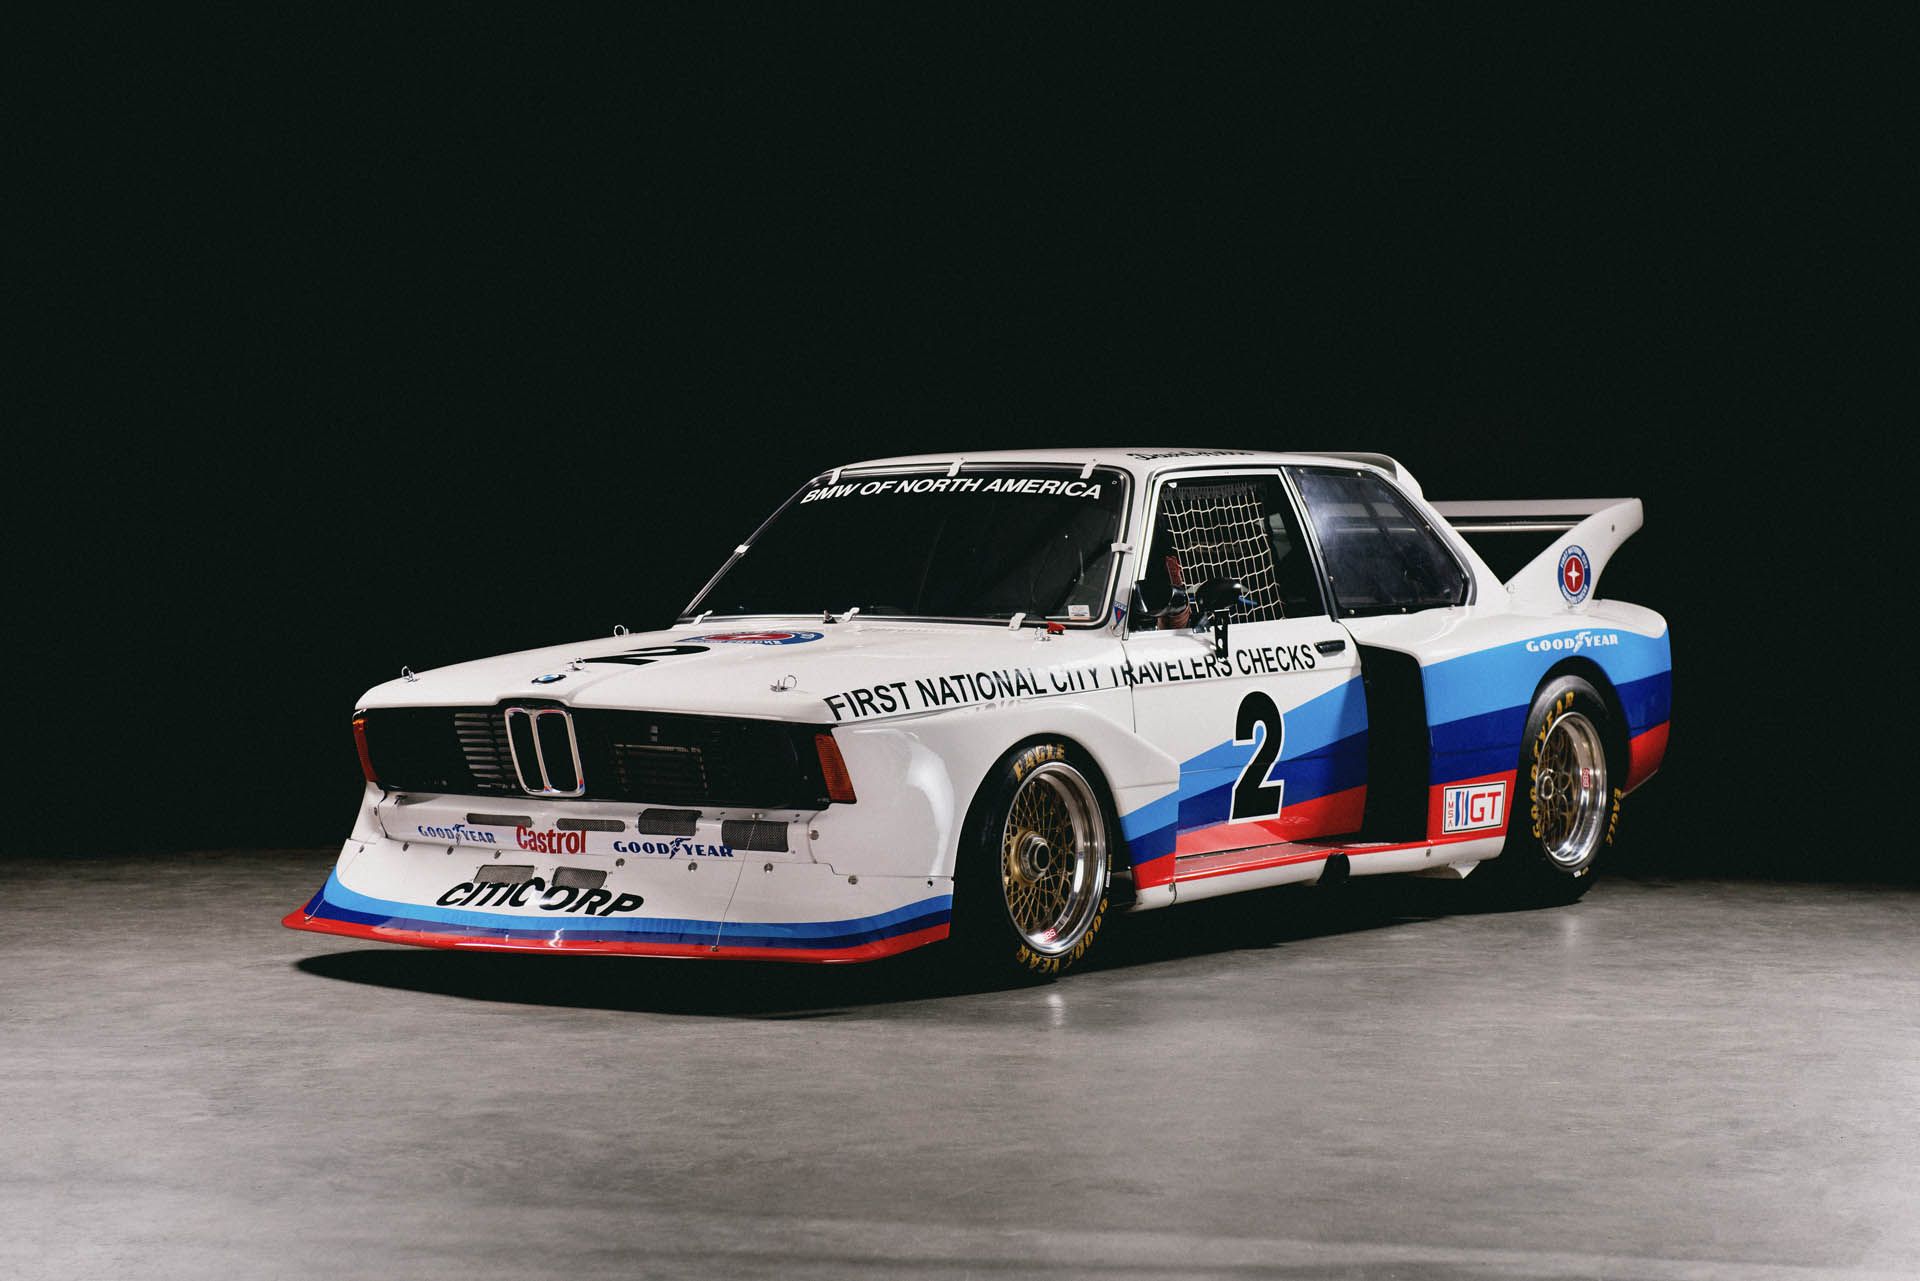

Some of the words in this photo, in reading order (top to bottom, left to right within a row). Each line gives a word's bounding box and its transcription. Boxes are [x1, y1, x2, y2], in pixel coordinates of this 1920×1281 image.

[800, 483, 860, 504] BMW
[860, 481, 897, 495] OF
[895, 478, 984, 494] NORTH
[983, 478, 1101, 499] AMERICA
[823, 682, 910, 721] FIRST
[915, 668, 1047, 707] NATIONAL
[1236, 643, 1316, 675] CHECKS
[1013, 744, 1065, 781] EAGLE
[1231, 690, 1283, 822] 2
[1470, 791, 1501, 822] GT
[516, 824, 587, 855] Castrol
[436, 877, 644, 917] CITICORP
